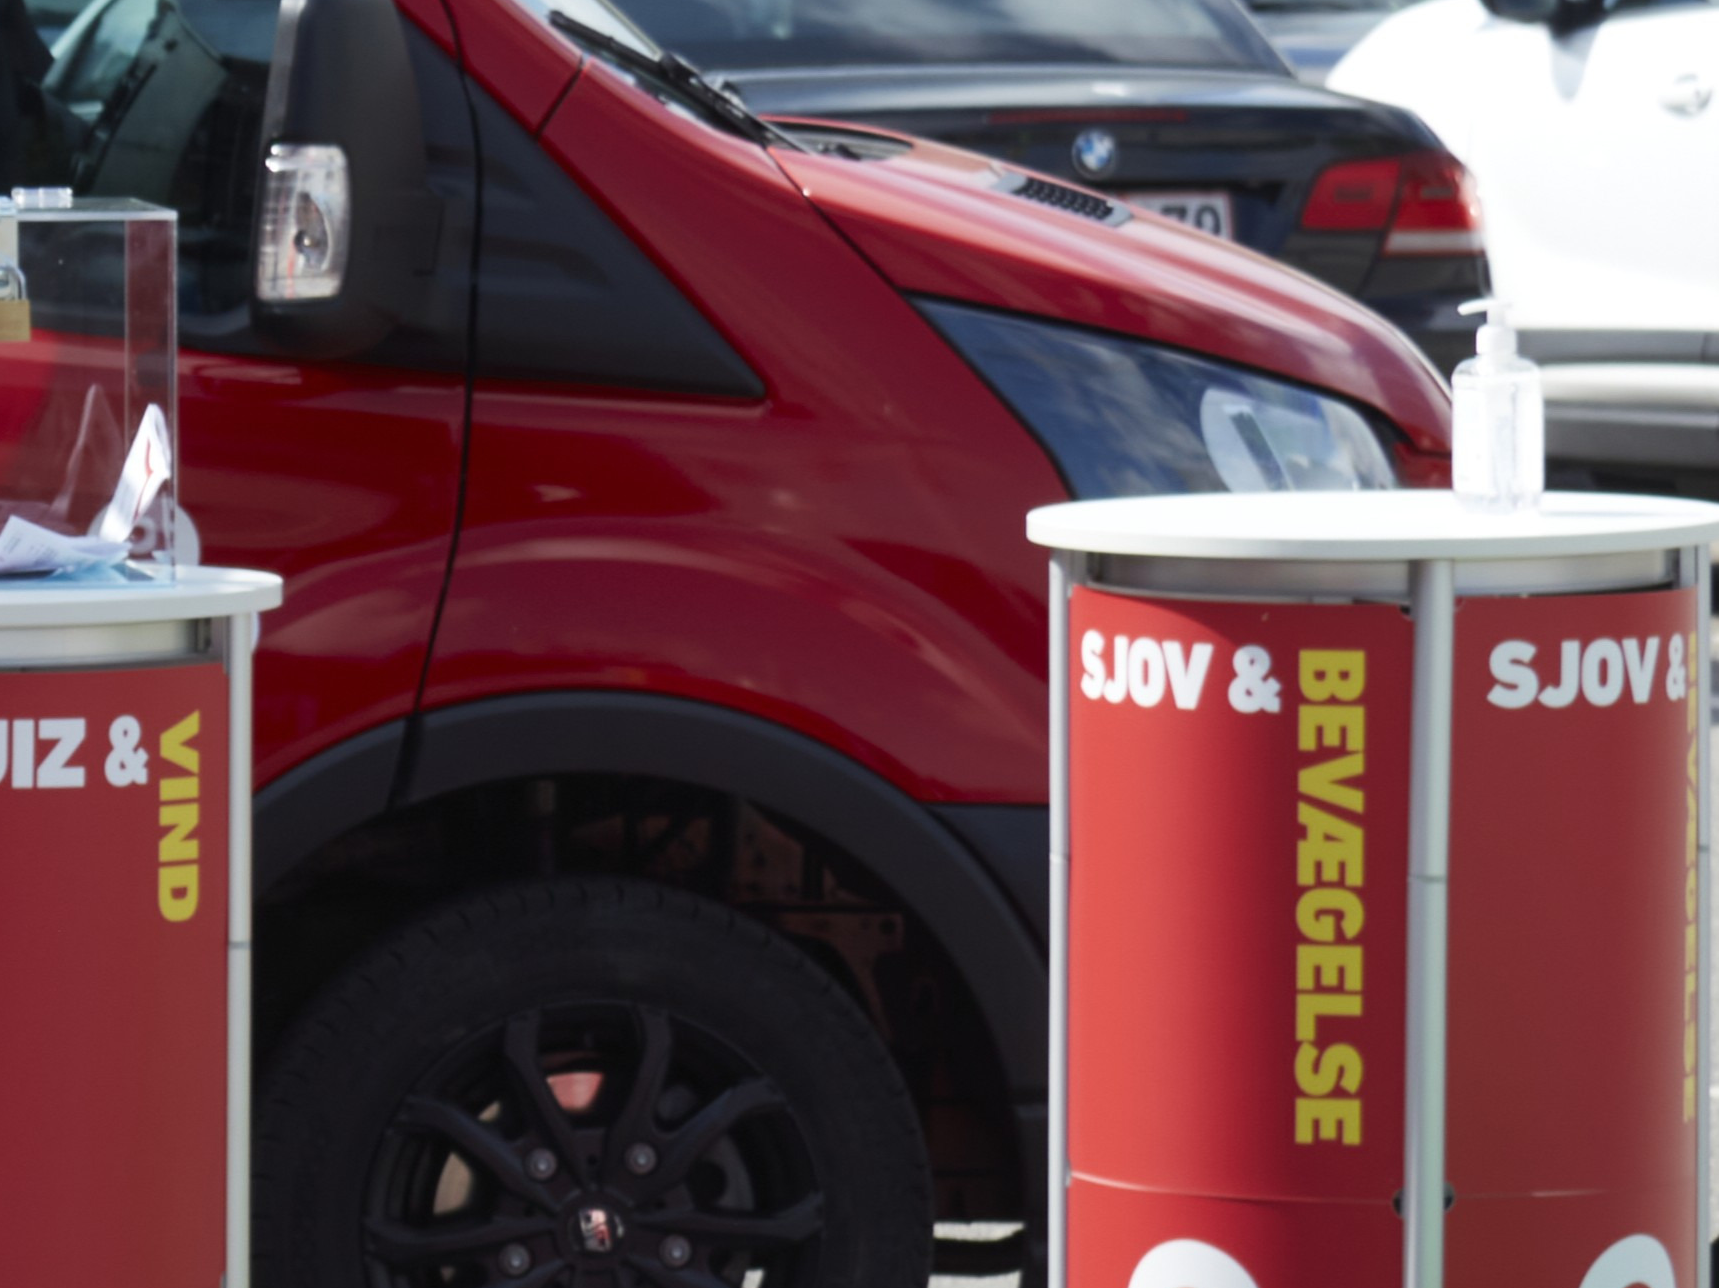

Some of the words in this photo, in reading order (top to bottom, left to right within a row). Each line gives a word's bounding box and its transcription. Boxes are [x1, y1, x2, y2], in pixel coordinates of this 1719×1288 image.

[1080, 629, 1213, 710] SJOV
[1228, 644, 1282, 713] &
[1487, 637, 1659, 709] SJOV
[1665, 632, 1686, 701] &
[104, 714, 149, 788] &
[158, 709, 200, 922] VIND
[1294, 648, 1366, 1146] BEVÆGELSE
